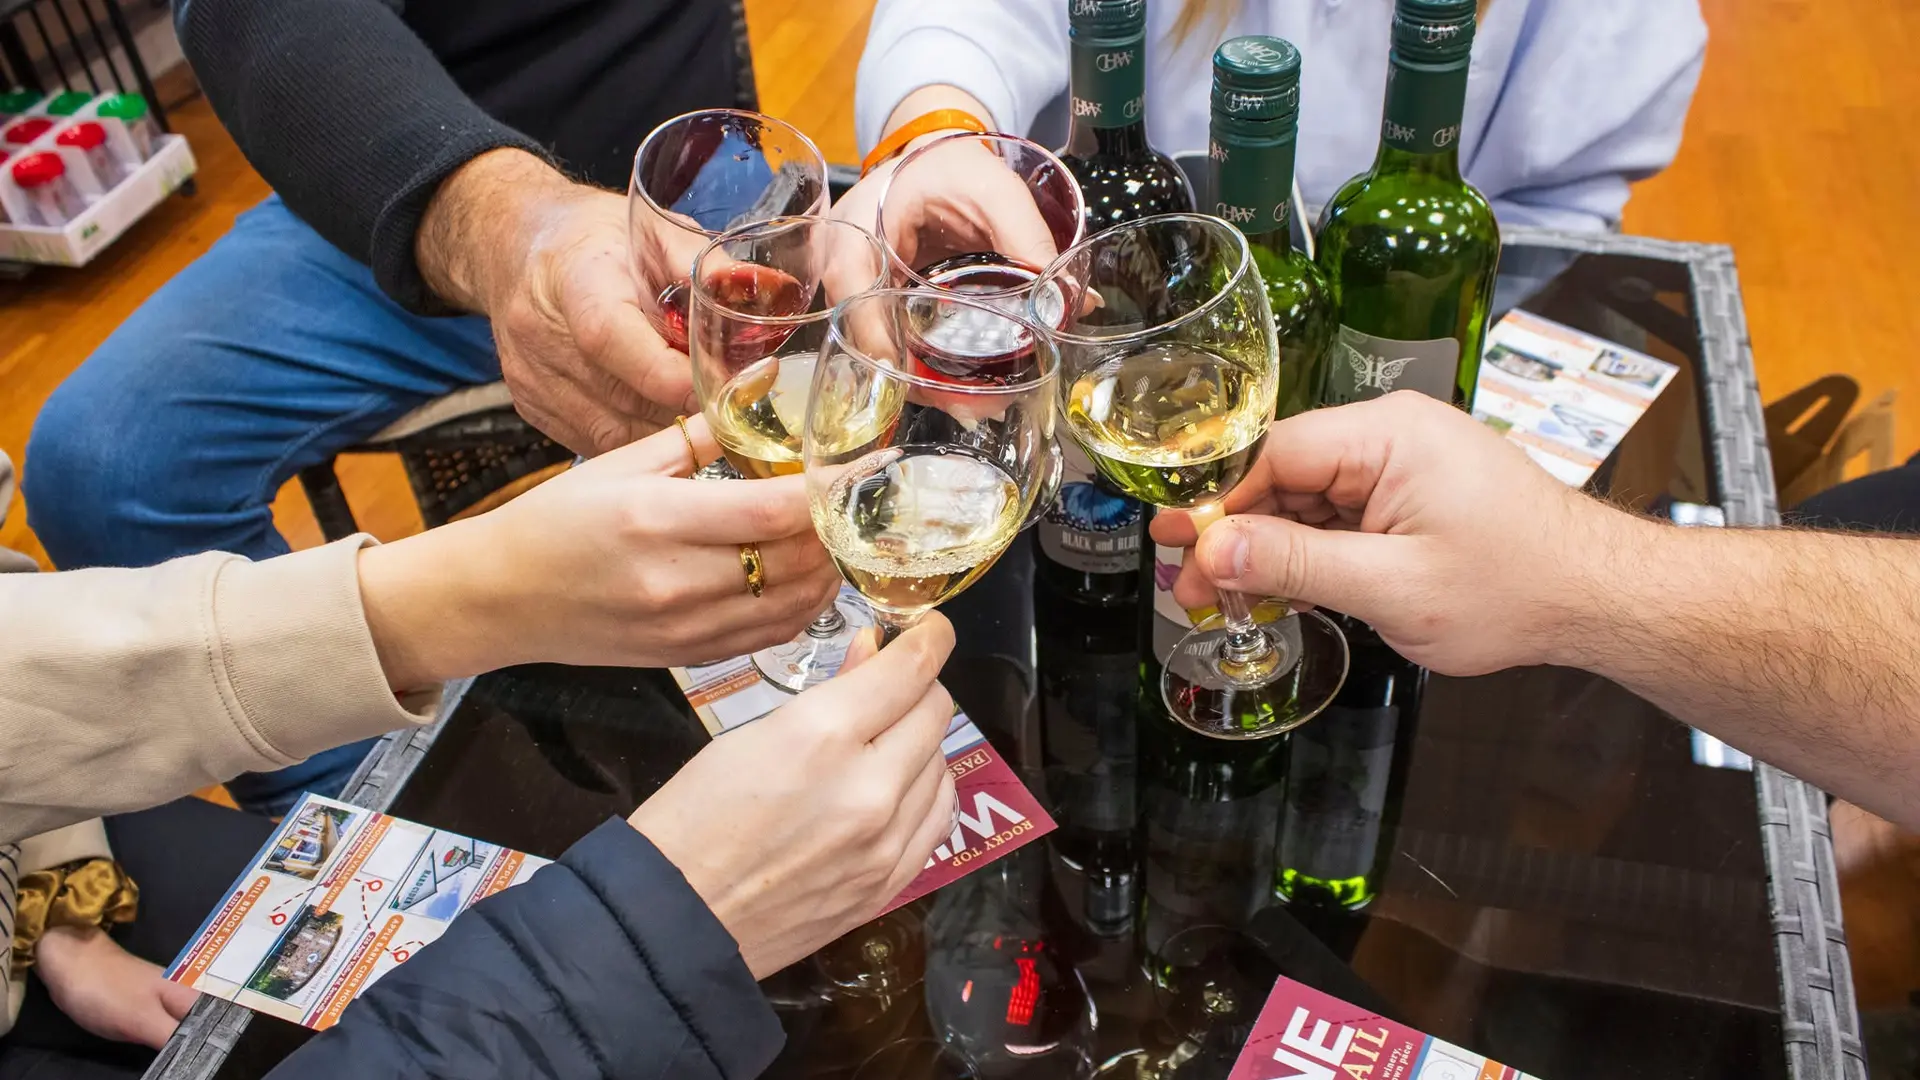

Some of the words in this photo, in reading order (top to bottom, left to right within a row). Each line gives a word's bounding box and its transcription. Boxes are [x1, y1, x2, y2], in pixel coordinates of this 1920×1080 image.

[1062, 530, 1091, 550] BLACK
[1095, 538, 1113, 552] and
[356, 823, 385, 860] MOUNTAIN
[984, 820, 1034, 851] ROCKY
[952, 847, 983, 867] TOP
[337, 858, 359, 886] VALLEY
[496, 859, 517, 884] APPLE
[246, 878, 265, 900] MILL
[316, 884, 340, 914] WINERY
[221, 898, 250, 934] BRIDGE
[380, 918, 399, 941] APPLE
[193, 933, 224, 972] WINERY
[364, 940, 384, 964] BARN
[348, 963, 368, 988] CIDER
[327, 988, 352, 1018] HOUSE
[1382, 1048, 1402, 1078] winery,
[1400, 1041, 1414, 1065] pace!
